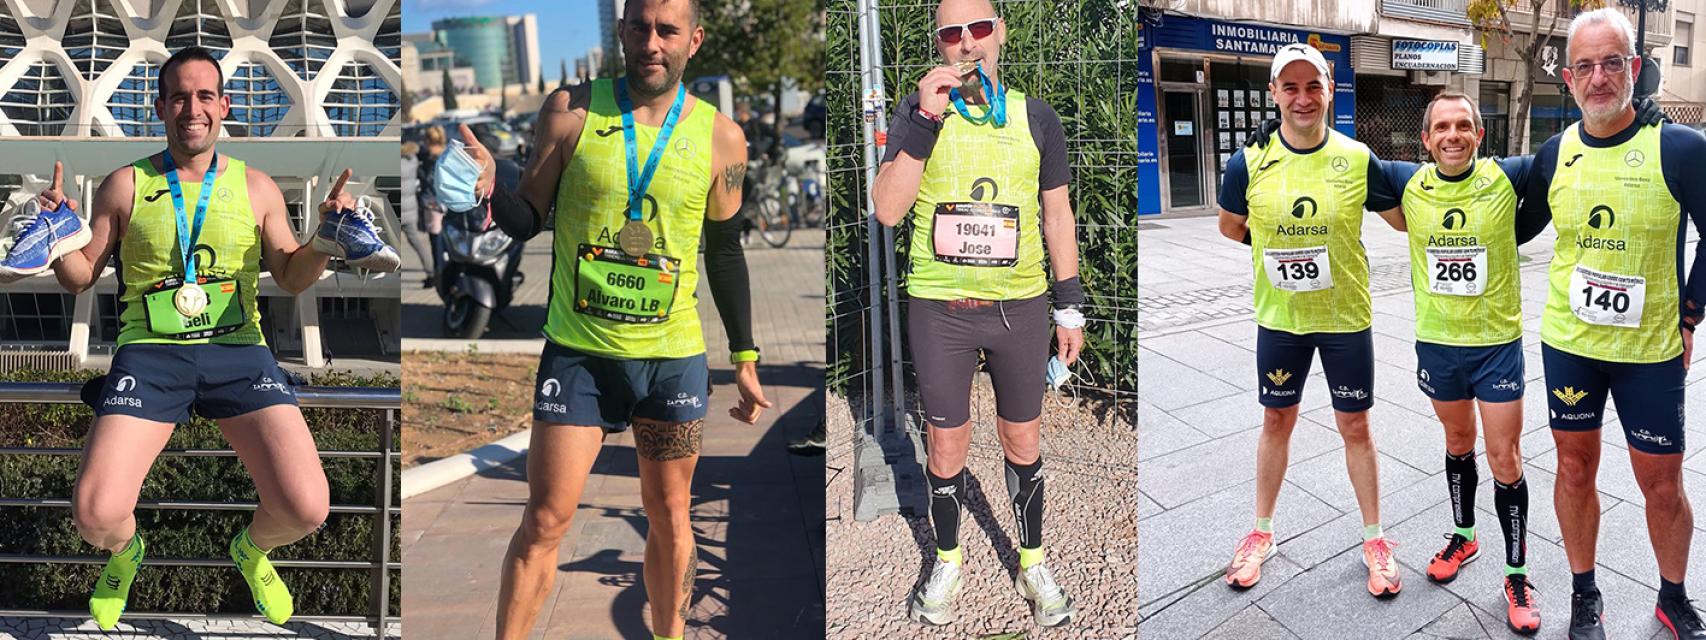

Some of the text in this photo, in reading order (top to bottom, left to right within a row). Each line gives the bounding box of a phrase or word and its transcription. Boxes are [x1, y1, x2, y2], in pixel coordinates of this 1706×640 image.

[1211, 24, 1299, 44] INMOBILIARIA
[1216, 39, 1283, 54] SANTAMAR
[1395, 41, 1457, 51] FOTOCOPIAS
[956, 222, 996, 237] 19041
[1276, 224, 1328, 236] Adarsa
[958, 241, 992, 255] Jose
[1427, 235, 1478, 247] Adarsa
[1575, 235, 1627, 251] Adarsa
[1277, 261, 1320, 281] 139
[1435, 262, 1477, 282] 266
[606, 271, 646, 291] 6660
[587, 288, 661, 313] Alvaro LB
[1582, 286, 1630, 314] 140
[1269, 389, 1296, 397] AQUONA
[103, 395, 143, 408] Adarsa
[536, 400, 567, 414] darsa
[1561, 412, 1596, 420] AQUONA
